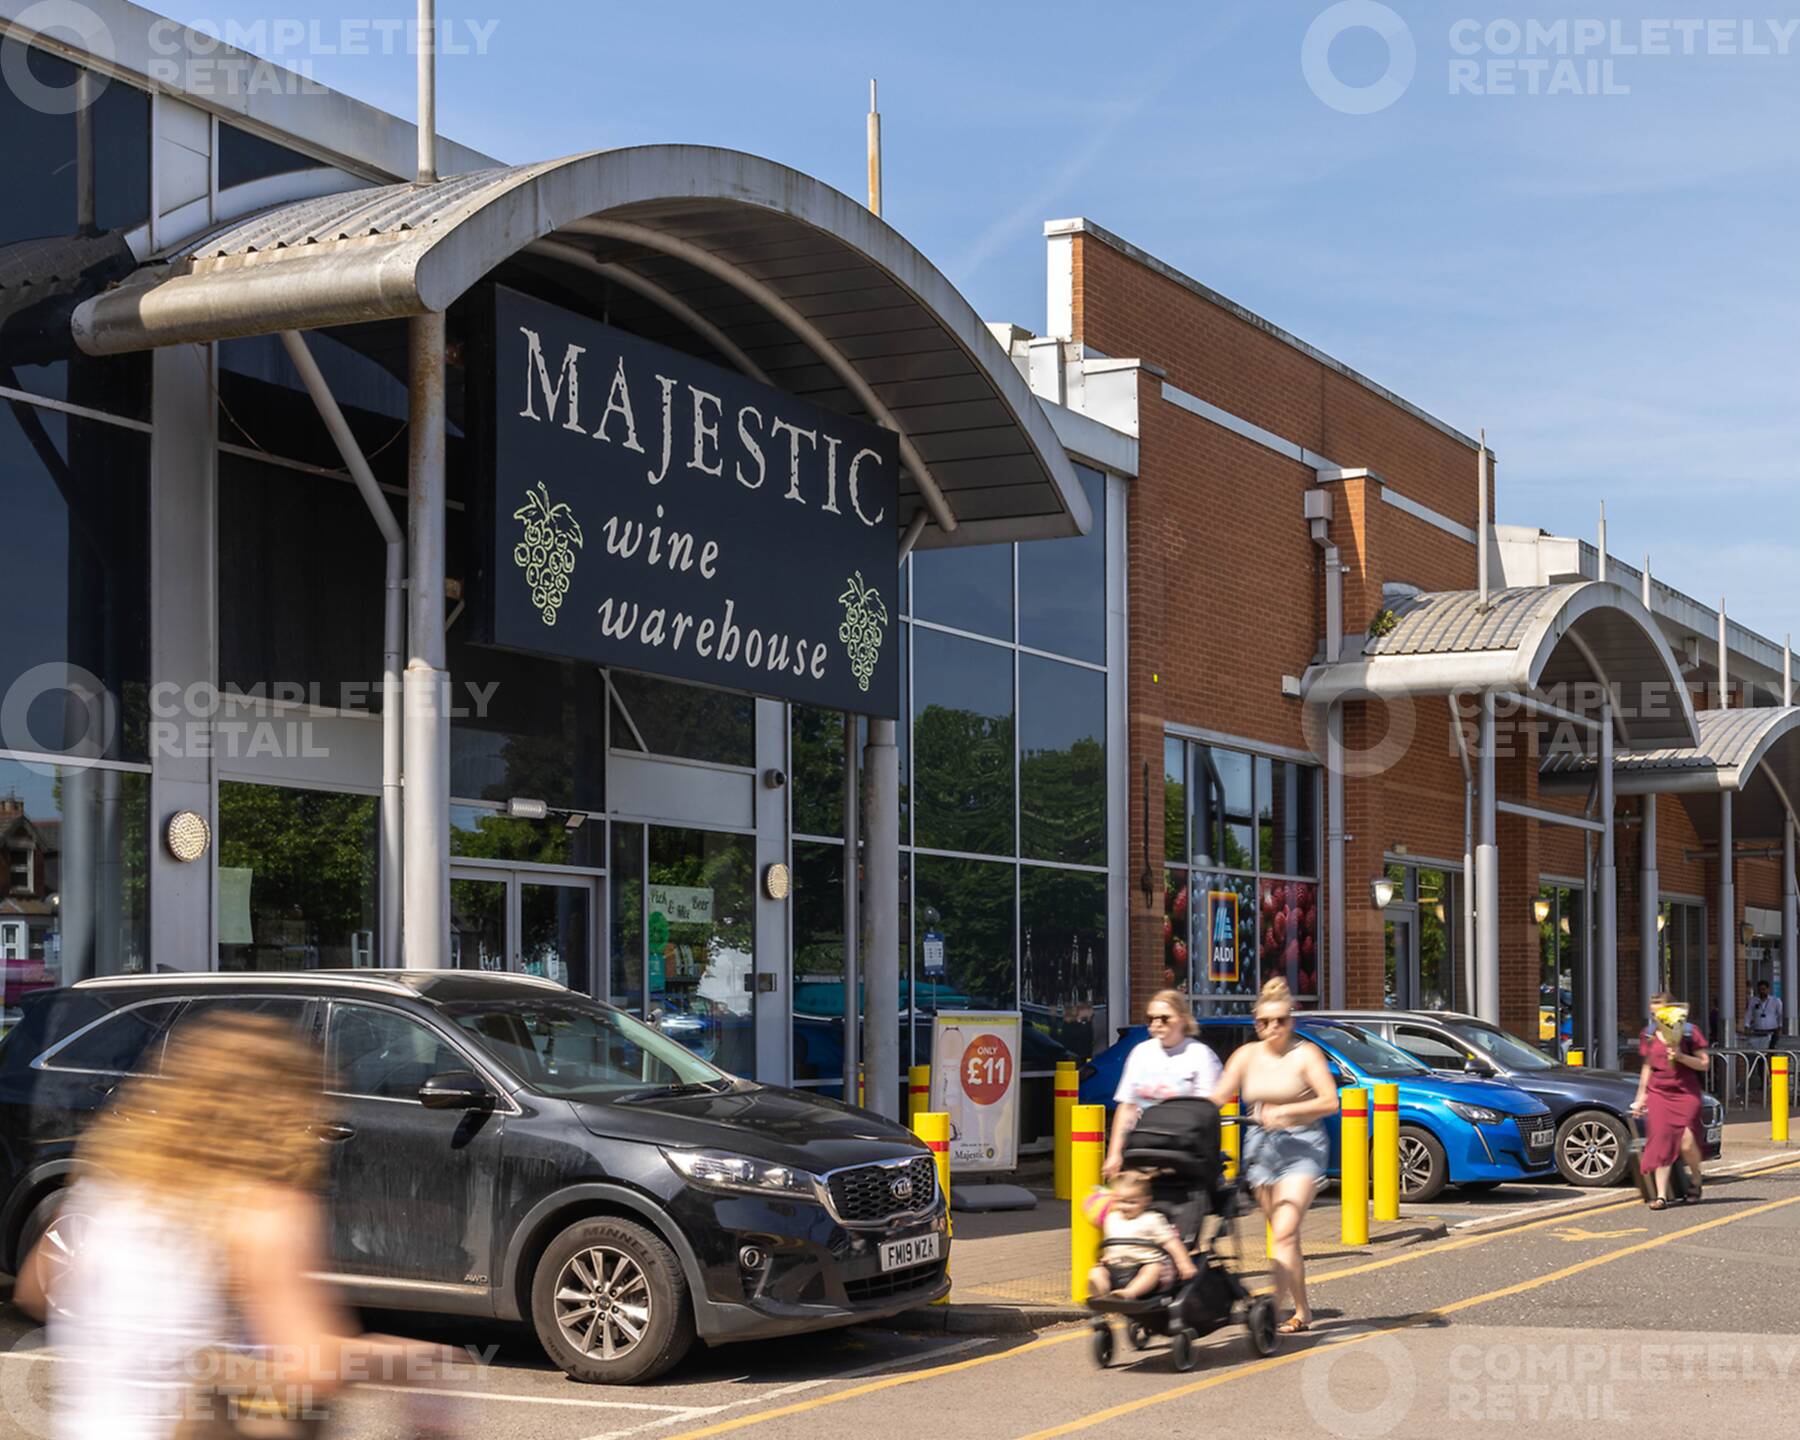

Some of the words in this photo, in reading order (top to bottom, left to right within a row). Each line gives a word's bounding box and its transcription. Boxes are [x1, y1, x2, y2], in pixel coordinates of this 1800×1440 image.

[519, 325, 884, 527] MAJESTIC
[603, 504, 719, 579] wine
[598, 599, 828, 680] warehouse
[1213, 946, 1234, 962] ALDI
[967, 1057, 1006, 1085] £11
[977, 1046, 998, 1056] ONLY
